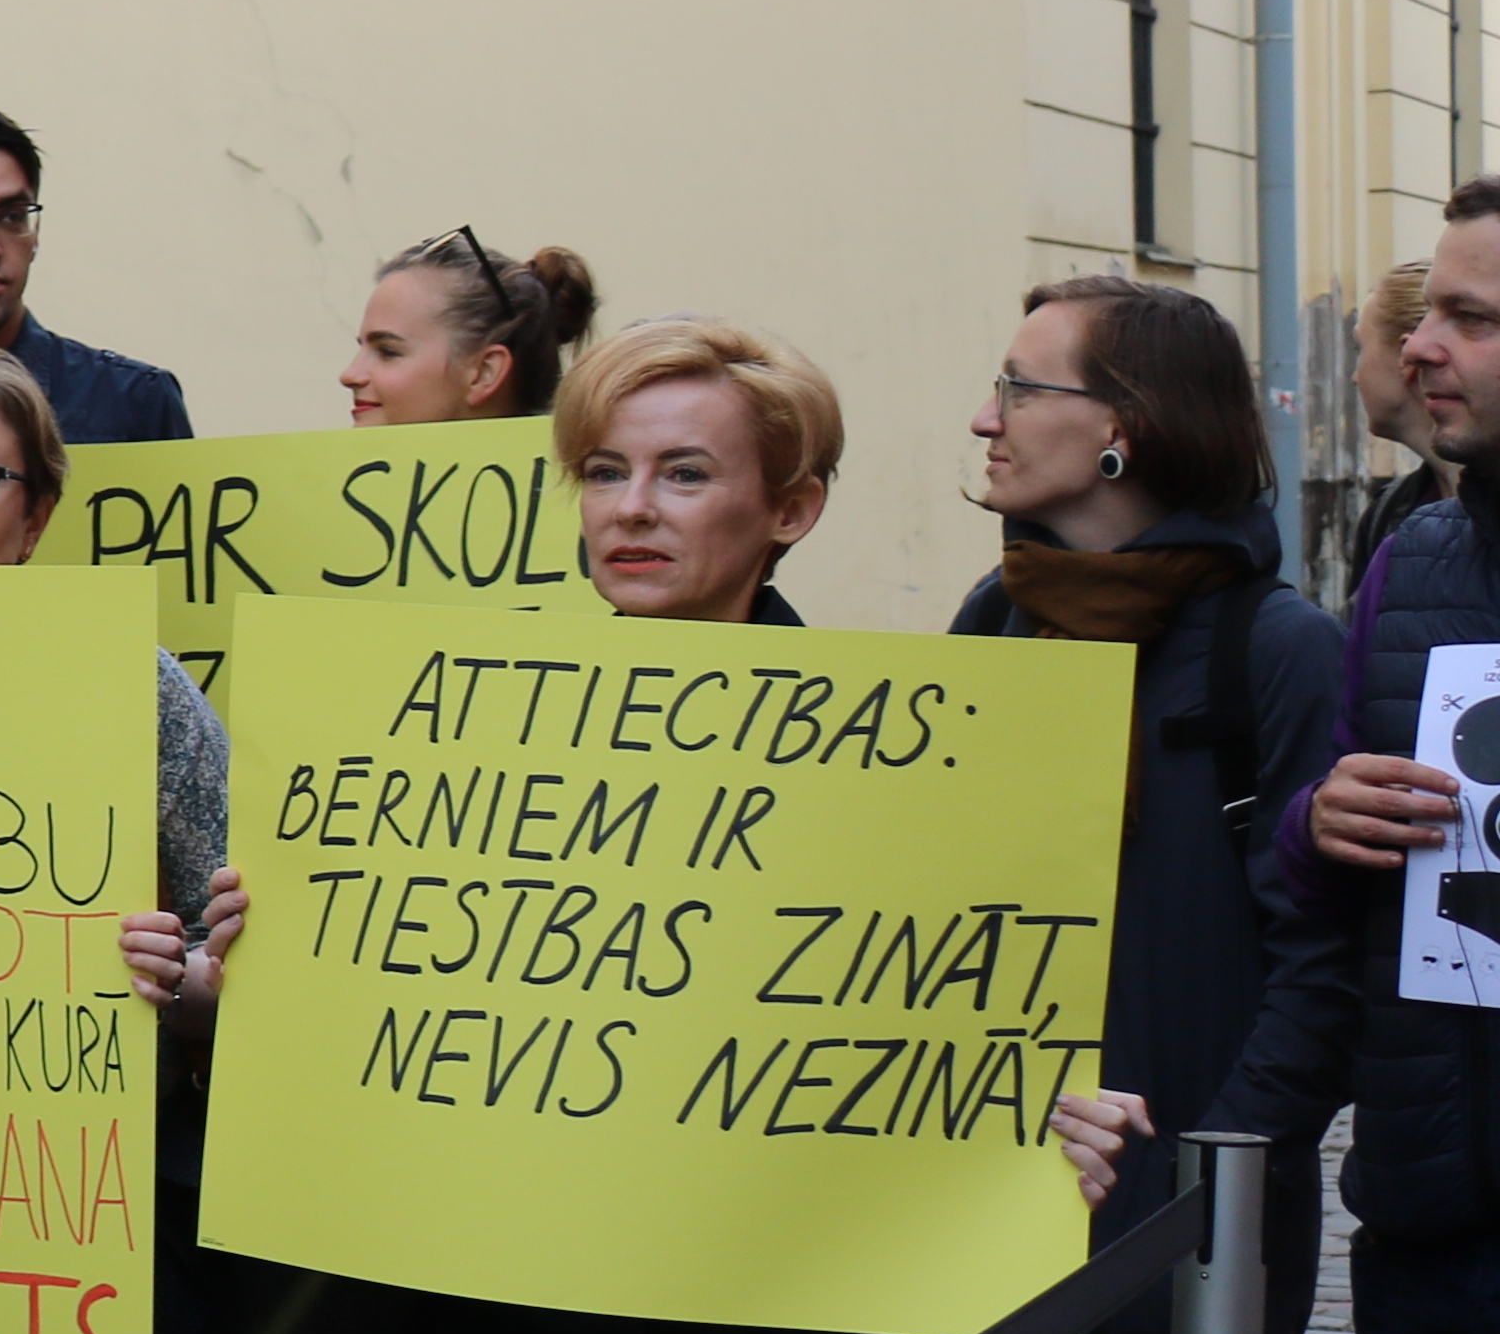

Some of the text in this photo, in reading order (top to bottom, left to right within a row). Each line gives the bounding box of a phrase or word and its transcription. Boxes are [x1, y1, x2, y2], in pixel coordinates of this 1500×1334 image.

[85, 456, 591, 604] PAR SKOL
[388, 648, 978, 770] ATTIECĪBAS:
[275, 756, 776, 872] BĒRNIEM IR
[755, 903, 1099, 1038] ZINĀT,
[5, 992, 131, 1095] KURĀ
[361, 1007, 1102, 1147] NEVIS NEZINĀT
